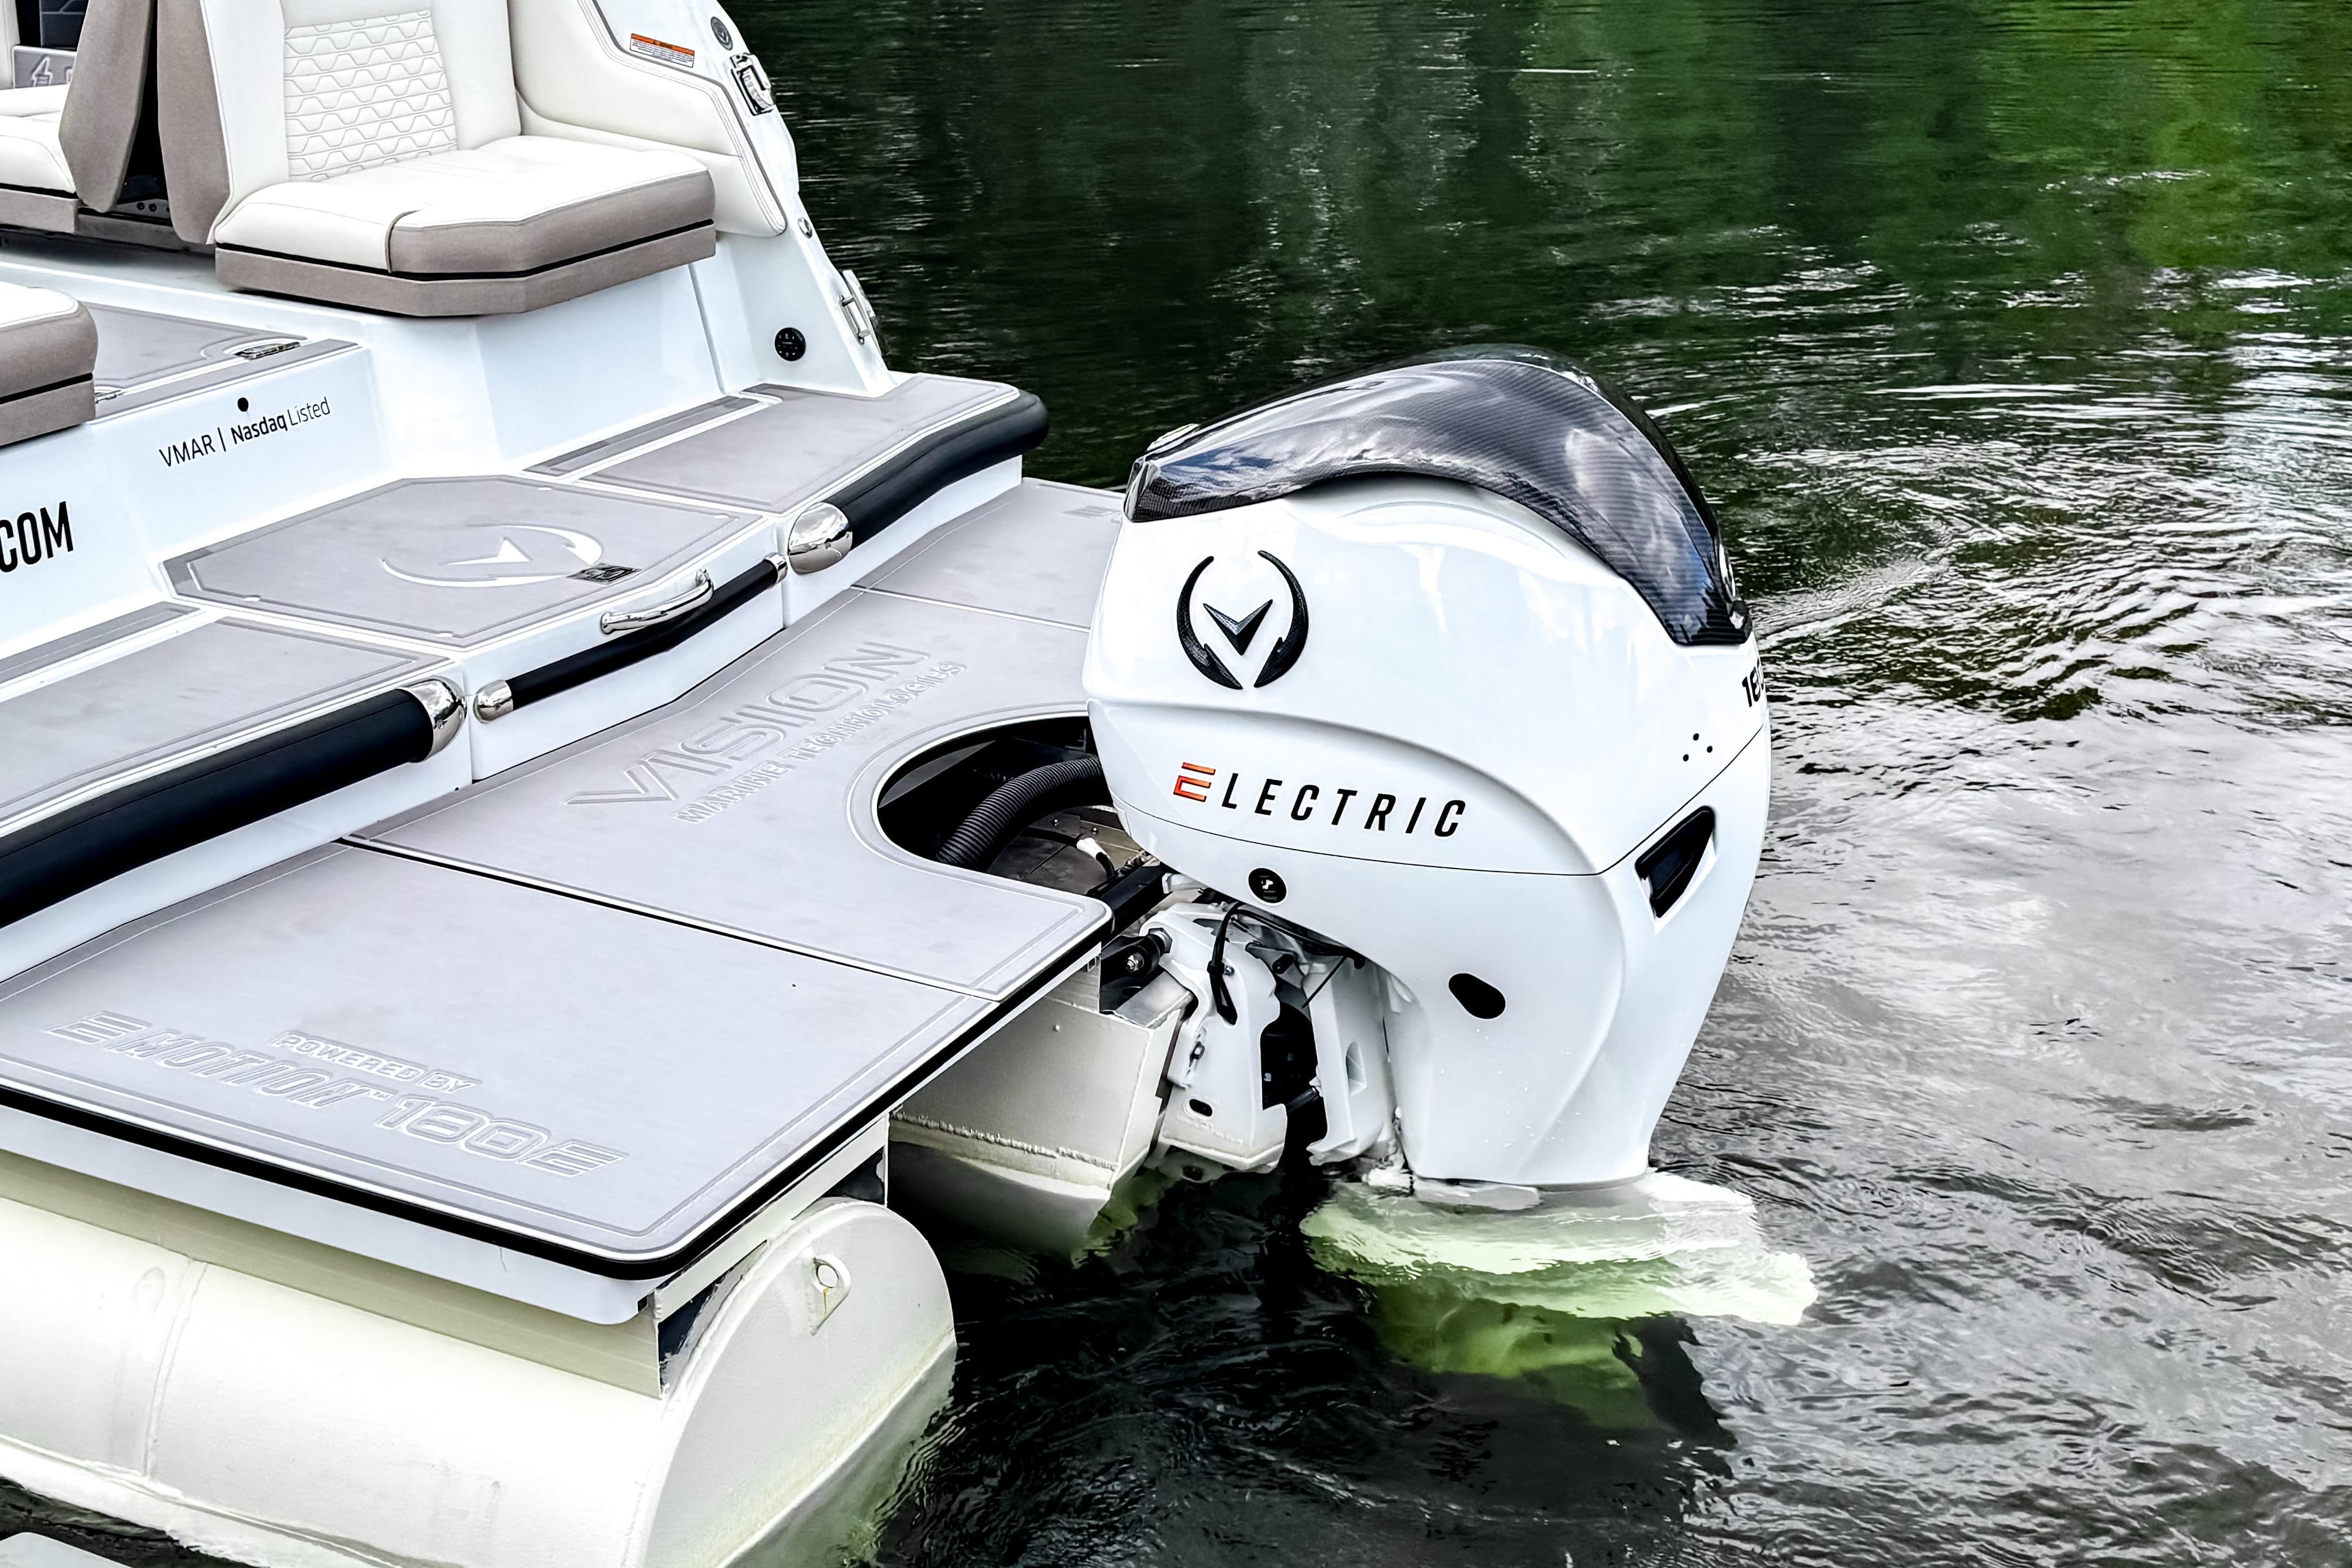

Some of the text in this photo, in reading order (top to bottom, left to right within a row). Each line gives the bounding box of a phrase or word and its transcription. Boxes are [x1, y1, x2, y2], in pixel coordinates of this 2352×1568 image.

[159, 434, 216, 467] VMAR
[230, 415, 288, 444] Nasdaq
[287, 396, 331, 426] Listed
[565, 641, 930, 804] VISION
[670, 661, 968, 824] MARINE TECHNOLOGIES
[1173, 762, 1466, 837] ELECTRIC
[271, 1030, 481, 1095] POWERED BY
